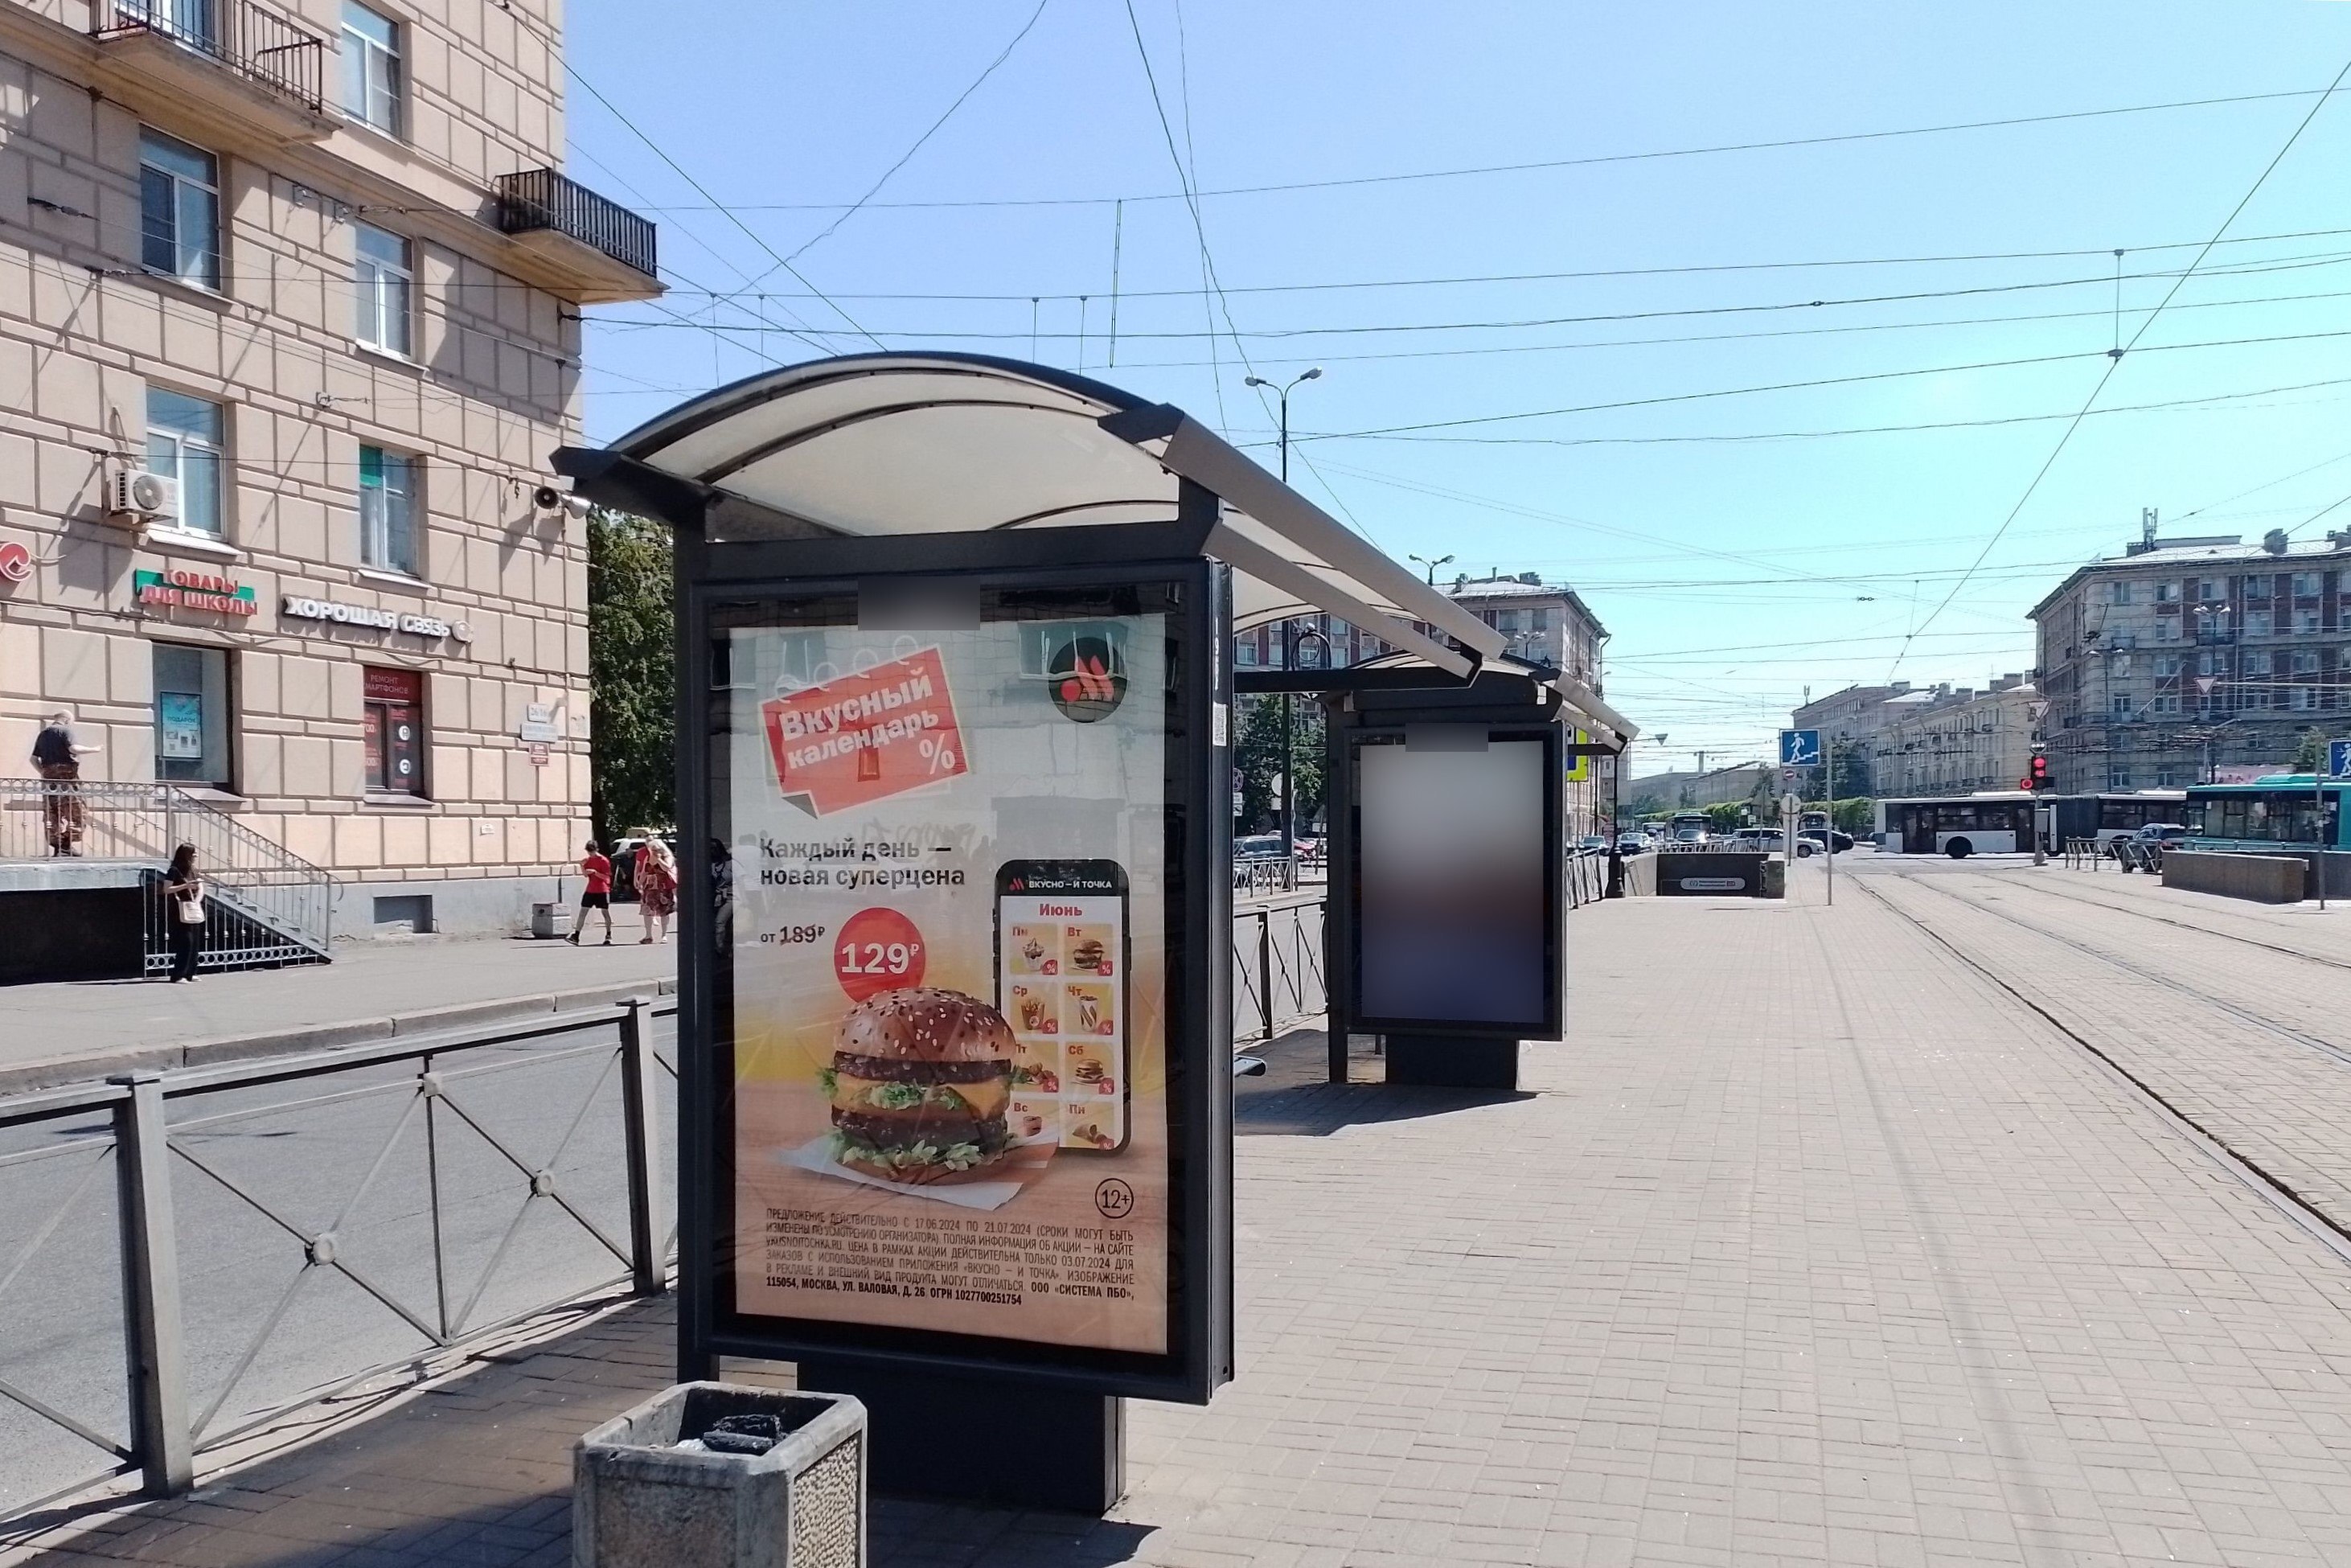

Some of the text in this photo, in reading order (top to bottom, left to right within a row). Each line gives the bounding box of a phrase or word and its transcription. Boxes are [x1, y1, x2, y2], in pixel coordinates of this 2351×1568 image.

[162, 569, 239, 595] ТОВАРЫ
[139, 585, 257, 616] ДЛЯ ШКОЛЫ
[285, 596, 451, 638] ХОРОШАЯ СВЯЗЬ
[364, 683, 408, 695] МАРТФОНОВ
[370, 675, 399, 684] РЕМОНТ
[778, 667, 933, 741] Вкусный
[787, 710, 939, 770] календарь
[919, 733, 955, 775] %
[761, 837, 855, 862] Каждый
[861, 841, 920, 862] день
[761, 869, 965, 889] новая суперцена
[1028, 880, 1065, 889] ВКУСНО
[1073, 880, 1080, 889] И
[1081, 880, 1112, 889] ТОЧКА
[1040, 904, 1083, 916] Июнь
[761, 933, 776, 943] от
[1012, 927, 1028, 937] Пн
[1068, 927, 1081, 937] Вт
[1012, 986, 1028, 997] Ср
[1068, 986, 1082, 996] Чт
[1069, 1045, 1084, 1055] Сб
[1014, 1102, 1028, 1112] Вс
[1069, 1105, 1085, 1114] Пн
[1101, 1189, 1130, 1209] 12+
[767, 1208, 1133, 1241] ПРЕДЛОЖЕНИЕ ДЕЙСТВИТЕЛЬНО С 17.06.2024 ПО 21.07.2024 (СРОКИ МОГУТ БЫТЬ
[766, 1223, 810, 1234] ИЗМЕНЕНЫ
[812, 1224, 823, 1236] ПО
[824, 1226, 876, 1240] УСМОТРЕНИЮ
[944, 1233, 976, 1246] ПОЛНАЯ
[979, 1235, 1036, 1251] ИНФОРМАЦИЯ
[1039, 1239, 1050, 1250] ОБ
[1052, 1240, 1081, 1254] АКЦИИ
[1093, 1243, 1105, 1256] НА
[1107, 1242, 1134, 1256] САЙТЕ
[848, 1242, 868, 1253] ЦЕНА
[873, 1243, 878, 1253] В
[882, 1244, 913, 1255] РАМКАХ
[918, 1246, 947, 1258] АКЦИИ
[951, 1246, 1020, 1262] ДЕЙСТВИТЕЛЬНА
[1024, 1251, 1057, 1265] ТОЛЬКО
[1061, 1255, 1110, 1268] 03.07.2024
[1115, 1258, 1133, 1271] ДЛЯ
[766, 1249, 802, 1262] ЗАКАЗОВ
[808, 1251, 813, 1262] С
[819, 1252, 894, 1268] ИСПОЛЬЗОВАНИЕМ
[900, 1258, 958, 1271] ПРИЛОЖЕНИЯ
[1017, 1266, 1024, 1277] И
[1068, 1270, 1134, 1285] ИЗОБРАЖЕНИЕ
[766, 1276, 799, 1290] 115054,
[802, 1278, 839, 1291] МОСКВА,
[843, 1281, 855, 1291] УЛ.
[859, 1282, 901, 1296] ВАЛОВАЯ,
[903, 1286, 912, 1298] Д.
[930, 1287, 952, 1299] ОГРН
[955, 1289, 1022, 1305] 1027700251754
[767, 1263, 772, 1273] В
[776, 1264, 813, 1276] РЕКЛАМЕ
[818, 1266, 823, 1276] И
[828, 1266, 870, 1279] ВНЕШНИЙ
[874, 1271, 891, 1283] ВИД
[895, 1271, 937, 1286] ПРОДУКТА
[941, 1275, 968, 1287] МОГУТ
[1031, 1281, 1049, 1293] ООО
[1054, 1283, 1102, 1298] «СИСТЕМА
